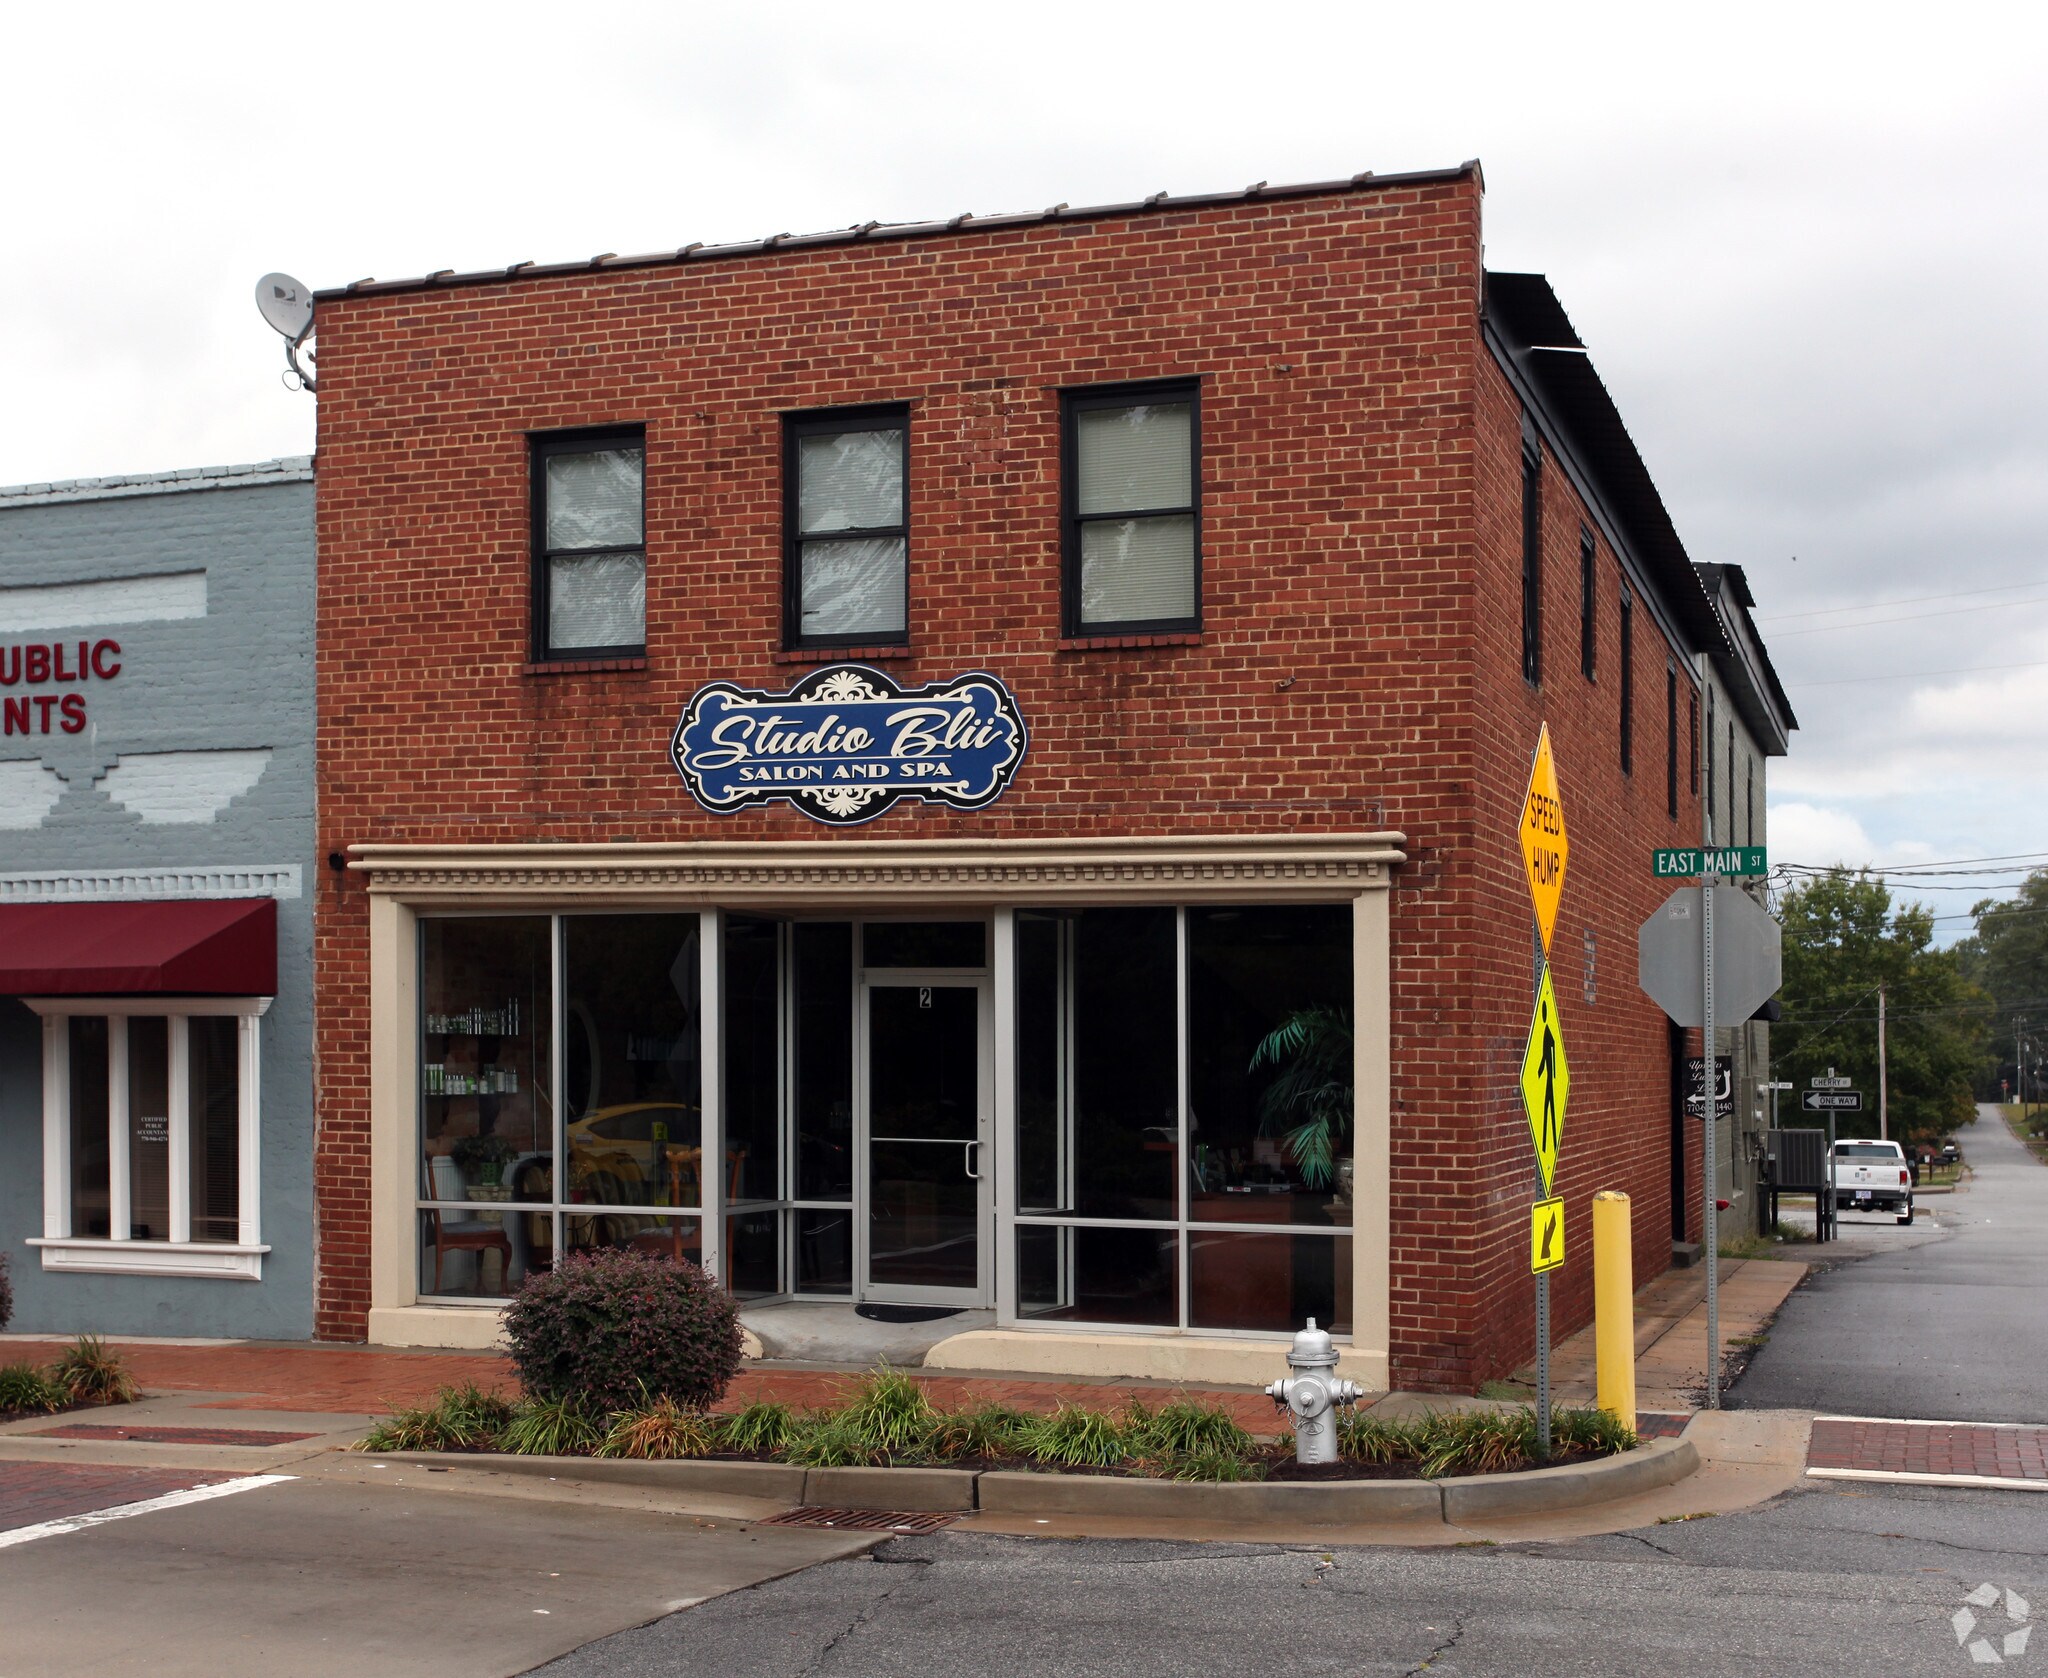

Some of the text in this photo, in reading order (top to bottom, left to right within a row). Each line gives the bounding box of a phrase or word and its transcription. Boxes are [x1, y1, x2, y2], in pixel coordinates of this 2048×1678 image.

[0, 638, 121, 685] UBLIC
[4, 693, 87, 735] NTS
[692, 714, 875, 769] Studio
[739, 762, 953, 781] SALON AND SPA
[1530, 791, 1560, 836] SPEED
[1533, 846, 1560, 887] HUMP
[1658, 851, 1761, 873] EAST MAIN ST
[921, 988, 930, 1007] 2
[1819, 1096, 1854, 1105] ONE WAY
